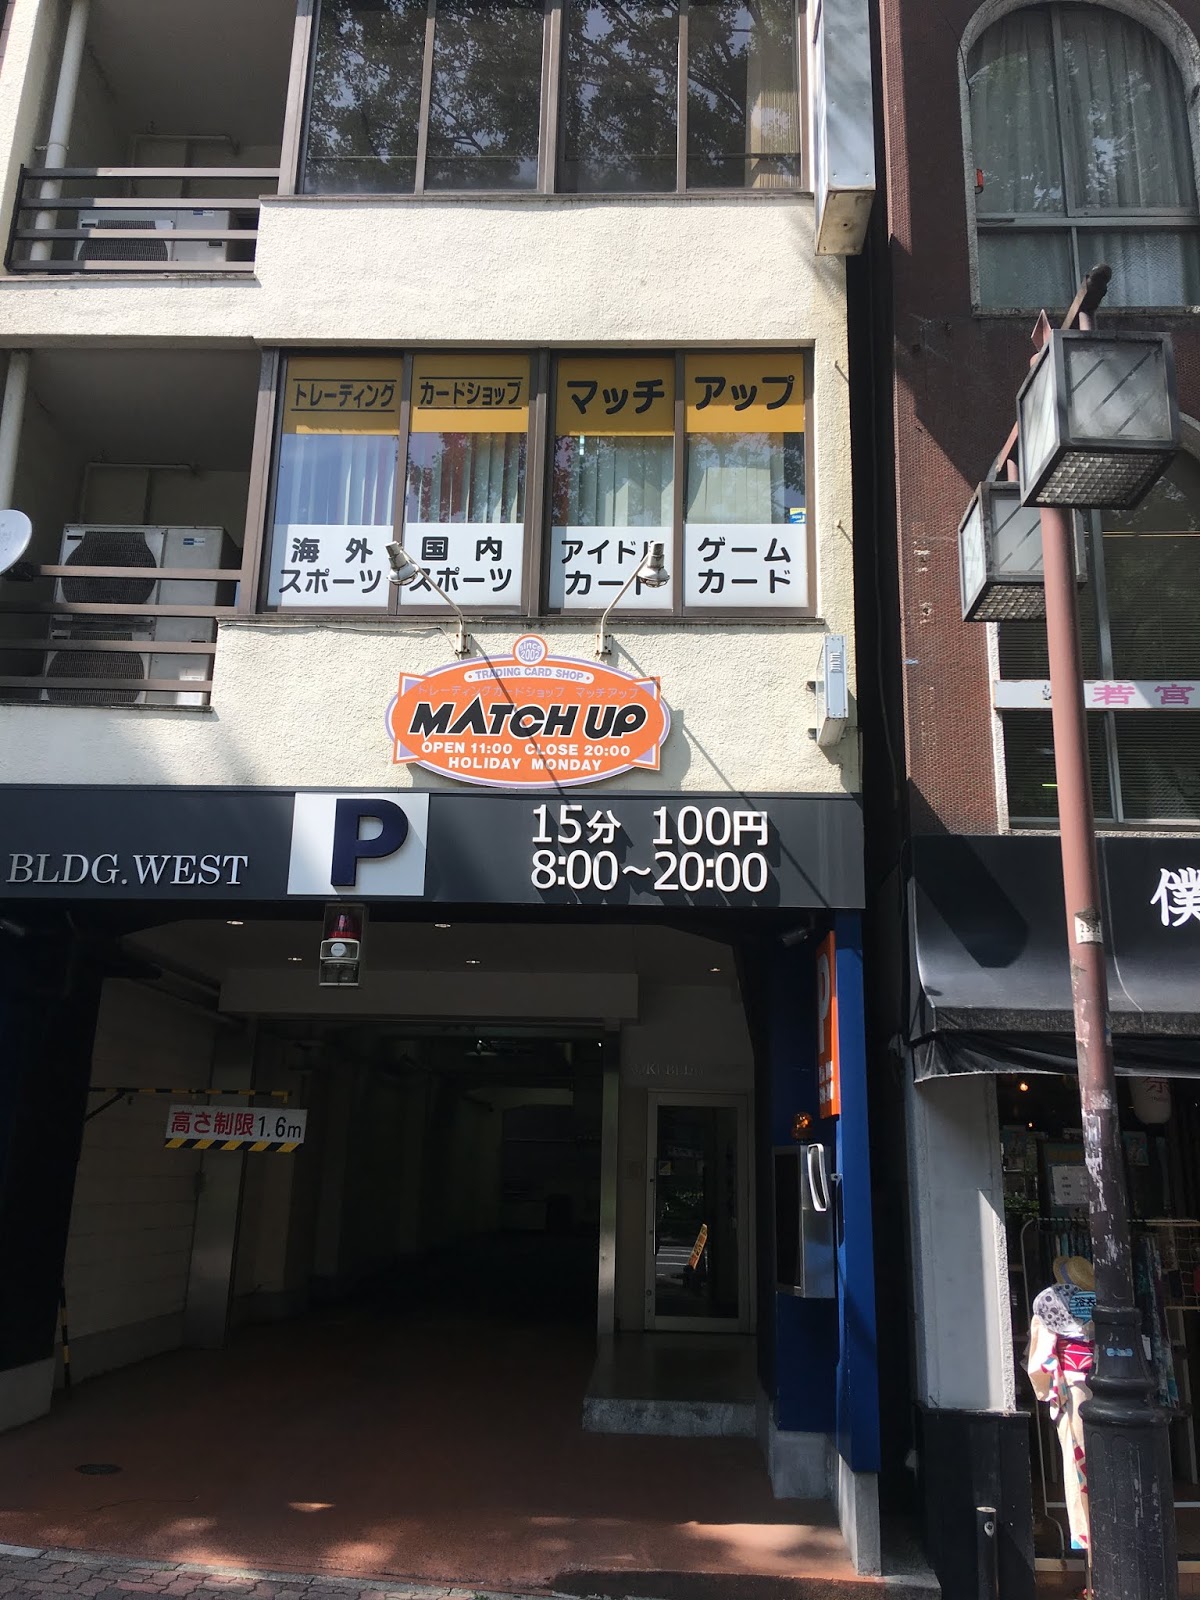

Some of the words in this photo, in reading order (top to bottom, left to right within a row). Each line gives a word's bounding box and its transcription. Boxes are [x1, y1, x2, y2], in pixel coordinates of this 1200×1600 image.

[296, 383, 395, 409] トレーディング
[419, 381, 522, 406] カードショップ
[566, 379, 665, 415] マッチ
[694, 374, 796, 412] アップ
[291, 537, 374, 564] 海外
[421, 536, 503, 562] 国内
[697, 537, 792, 563] ゲーム
[278, 568, 382, 594] スポーツ
[409, 566, 512, 593] スポーツ
[699, 567, 792, 594] カード
[519, 641, 542, 652] since
[520, 649, 541, 660] 2002
[475, 667, 521, 680] TRADING
[524, 667, 552, 677] CARD
[555, 669, 584, 681] SHOP
[408, 695, 581, 739] MATCH
[583, 703, 647, 740] UP
[421, 740, 465, 754] OPEN
[470, 742, 513, 755] 11:00
[524, 743, 579, 756] CLOSE
[584, 744, 631, 757] 20:00
[448, 756, 521, 770] HOLIDAY
[531, 758, 602, 771] MONDAY
[531, 804, 622, 844] 15分
[652, 805, 768, 846] 100円
[330, 798, 409, 886] P
